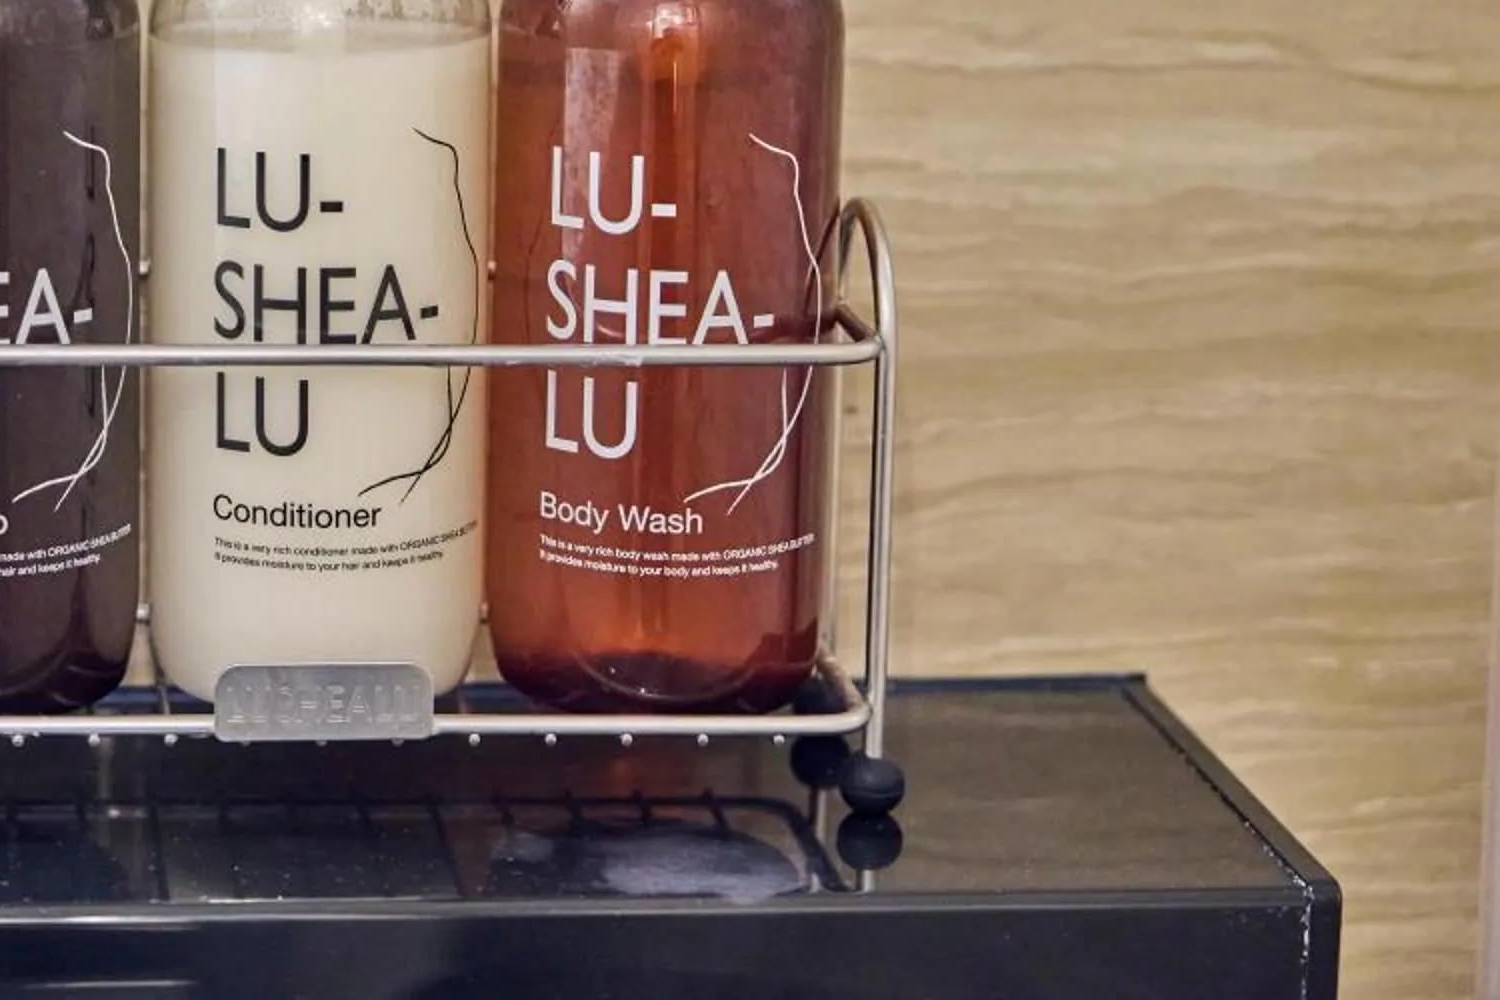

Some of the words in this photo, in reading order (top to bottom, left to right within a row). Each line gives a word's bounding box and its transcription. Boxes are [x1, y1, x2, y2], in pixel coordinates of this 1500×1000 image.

[217, 147, 343, 232] LU-
[551, 146, 677, 236] LU-
[213, 260, 439, 345] SHEA-
[547, 259, 774, 345] SHEA-
[216, 371, 309, 457] LU
[545, 369, 638, 459] LU
[213, 494, 382, 529] Conditioner
[540, 491, 610, 535] Body
[617, 503, 703, 534] Wash
[27, 548, 46, 560] with
[214, 536, 233, 549] This
[293, 546, 348, 557] conditioner
[305, 561, 316, 570] to
[317, 562, 340, 573] your
[362, 559, 380, 569] and
[539, 533, 557, 547] This
[595, 546, 614, 557] rich
[615, 548, 640, 560] body
[641, 551, 669, 561] wash
[671, 552, 699, 561] made
[701, 551, 720, 561] with
[17, 564, 36, 575] and
[627, 564, 639, 574] to
[639, 565, 663, 577] your
[663, 566, 689, 578] body
[691, 566, 710, 577] and
